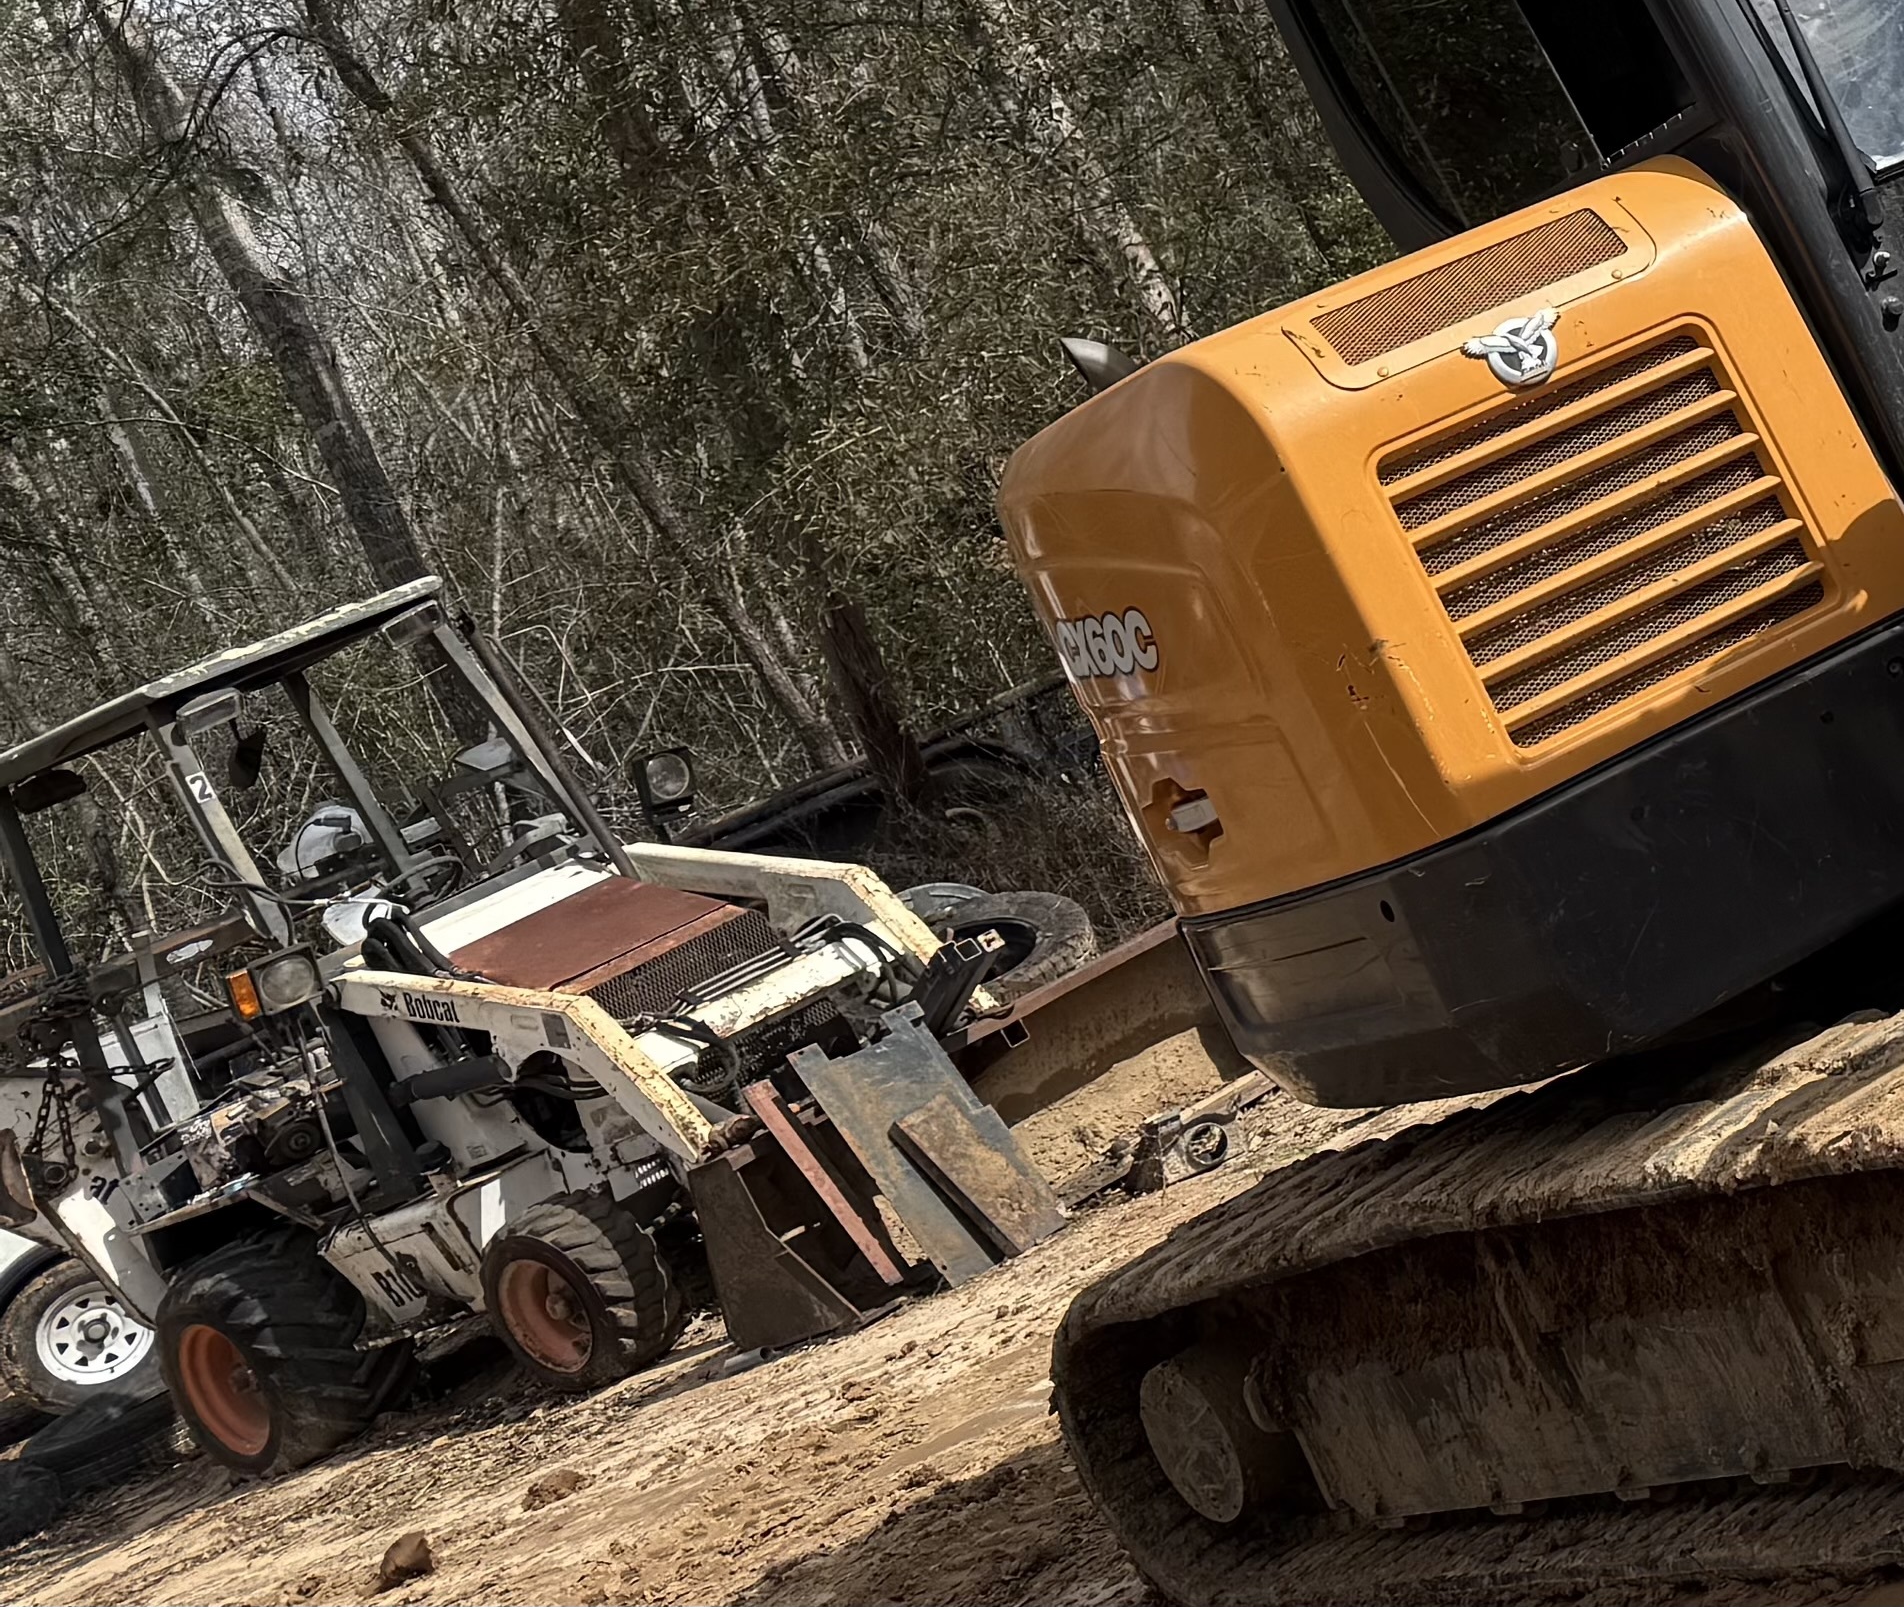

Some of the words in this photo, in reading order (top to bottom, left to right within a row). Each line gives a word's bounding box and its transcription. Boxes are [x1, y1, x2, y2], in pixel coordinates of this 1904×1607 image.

[1056, 606, 1159, 678] CX60C
[189, 775, 213, 800] 2
[402, 992, 460, 1023] Bobcat
